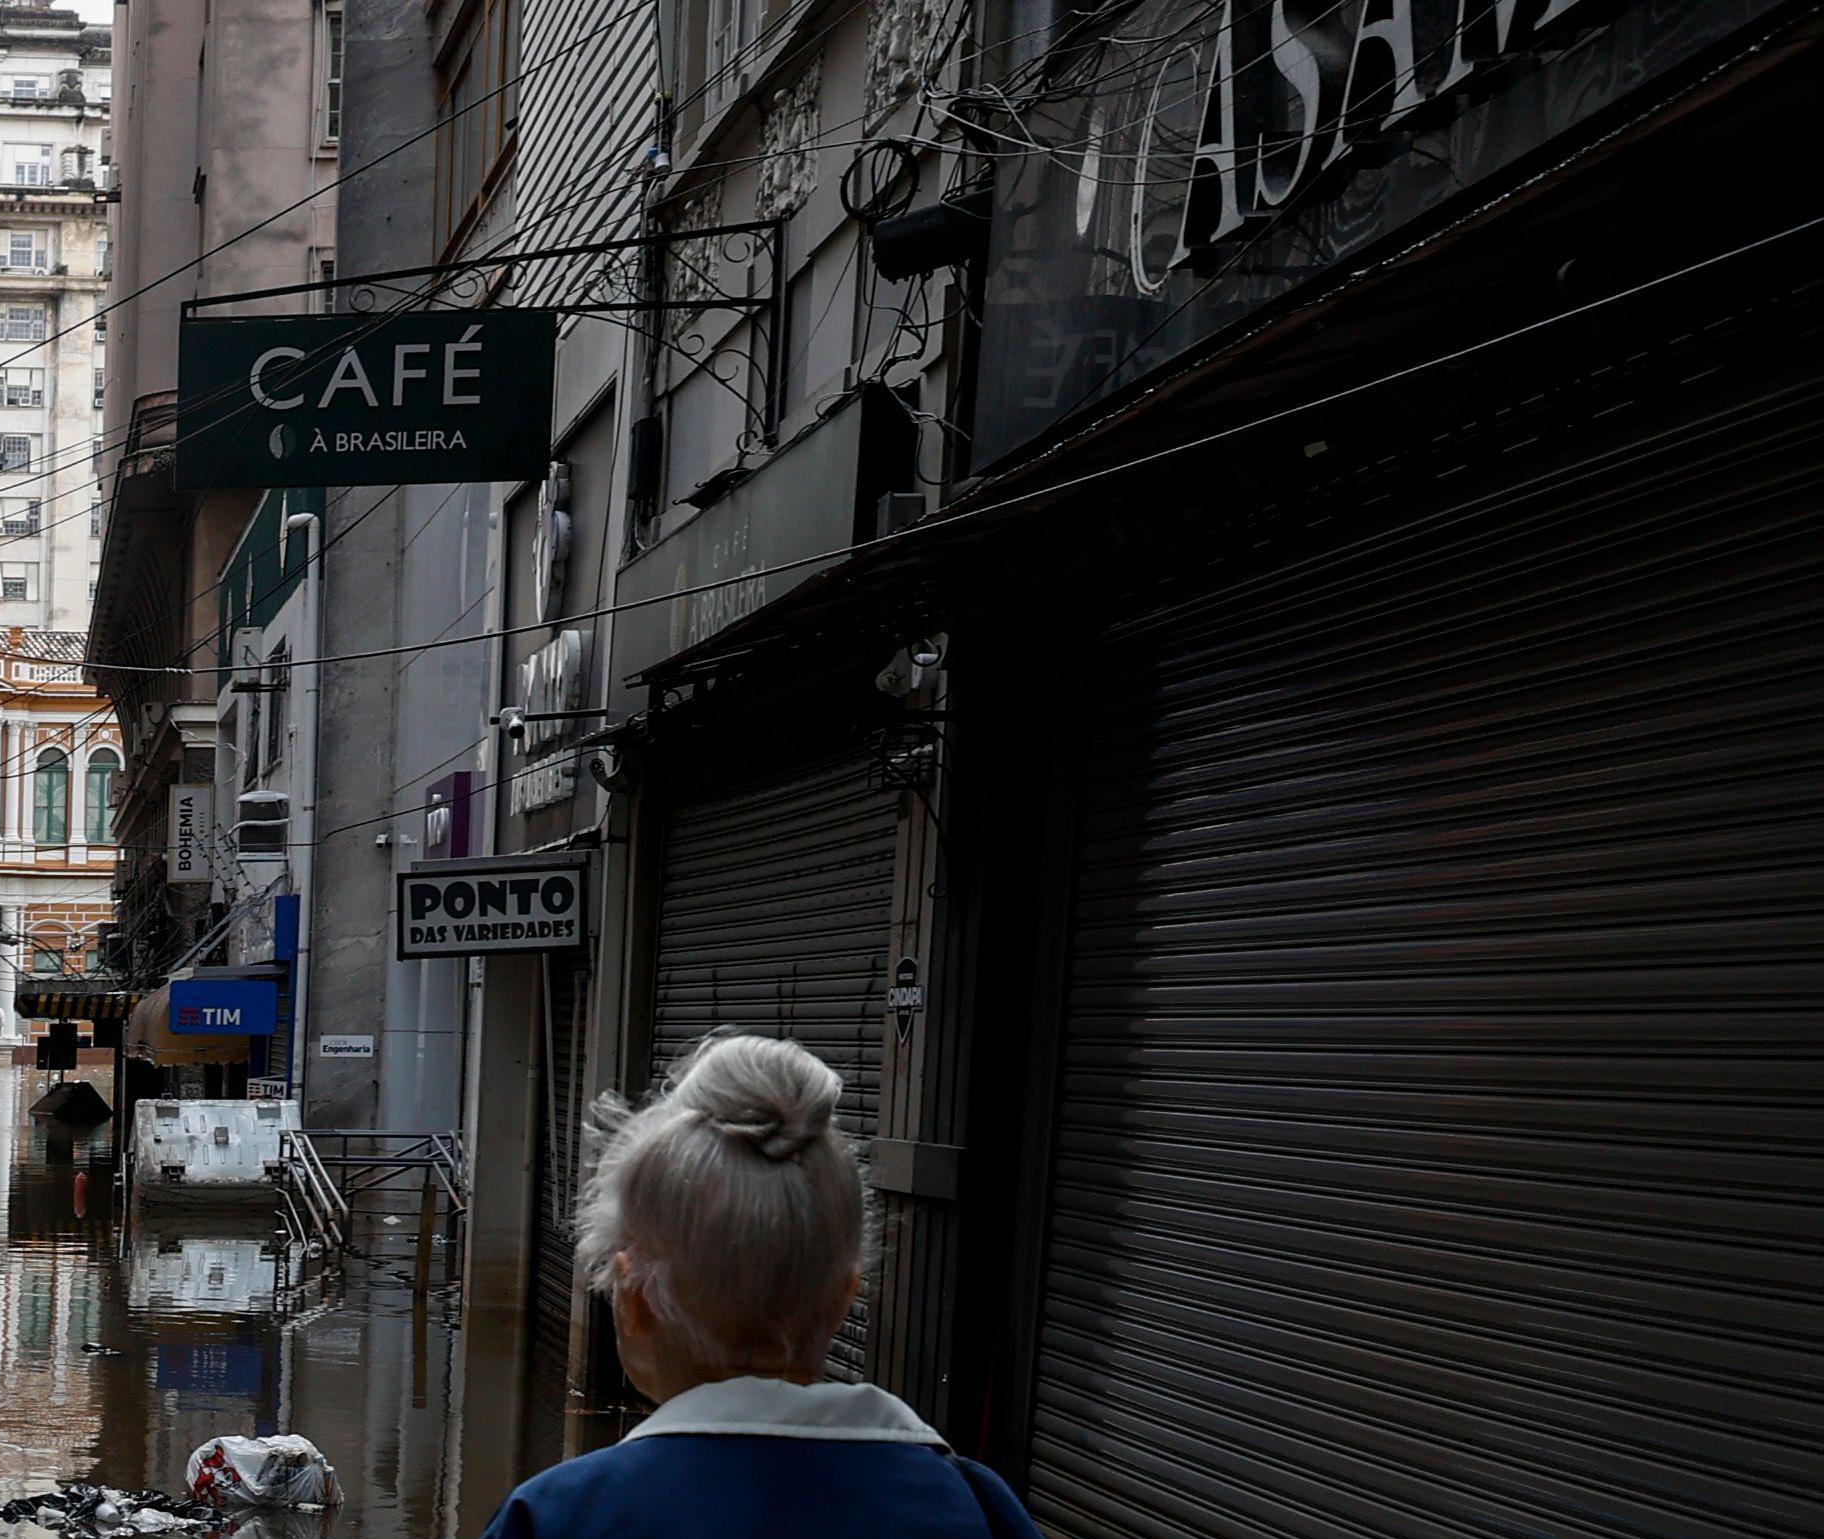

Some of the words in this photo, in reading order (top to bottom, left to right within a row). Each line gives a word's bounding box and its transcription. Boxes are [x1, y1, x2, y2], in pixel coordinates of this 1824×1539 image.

[250, 324, 485, 411] CAFÉ
[336, 429, 467, 452] BRASILEIRA
[178, 796, 194, 871] BOHEMIA
[410, 876, 574, 920] PONTO
[410, 925, 447, 944] DAS
[454, 919, 575, 942] VARIEDADES
[202, 1007, 241, 1026] TIM
[322, 1044, 371, 1055] Engenharia
[262, 1083, 285, 1097] TIM
